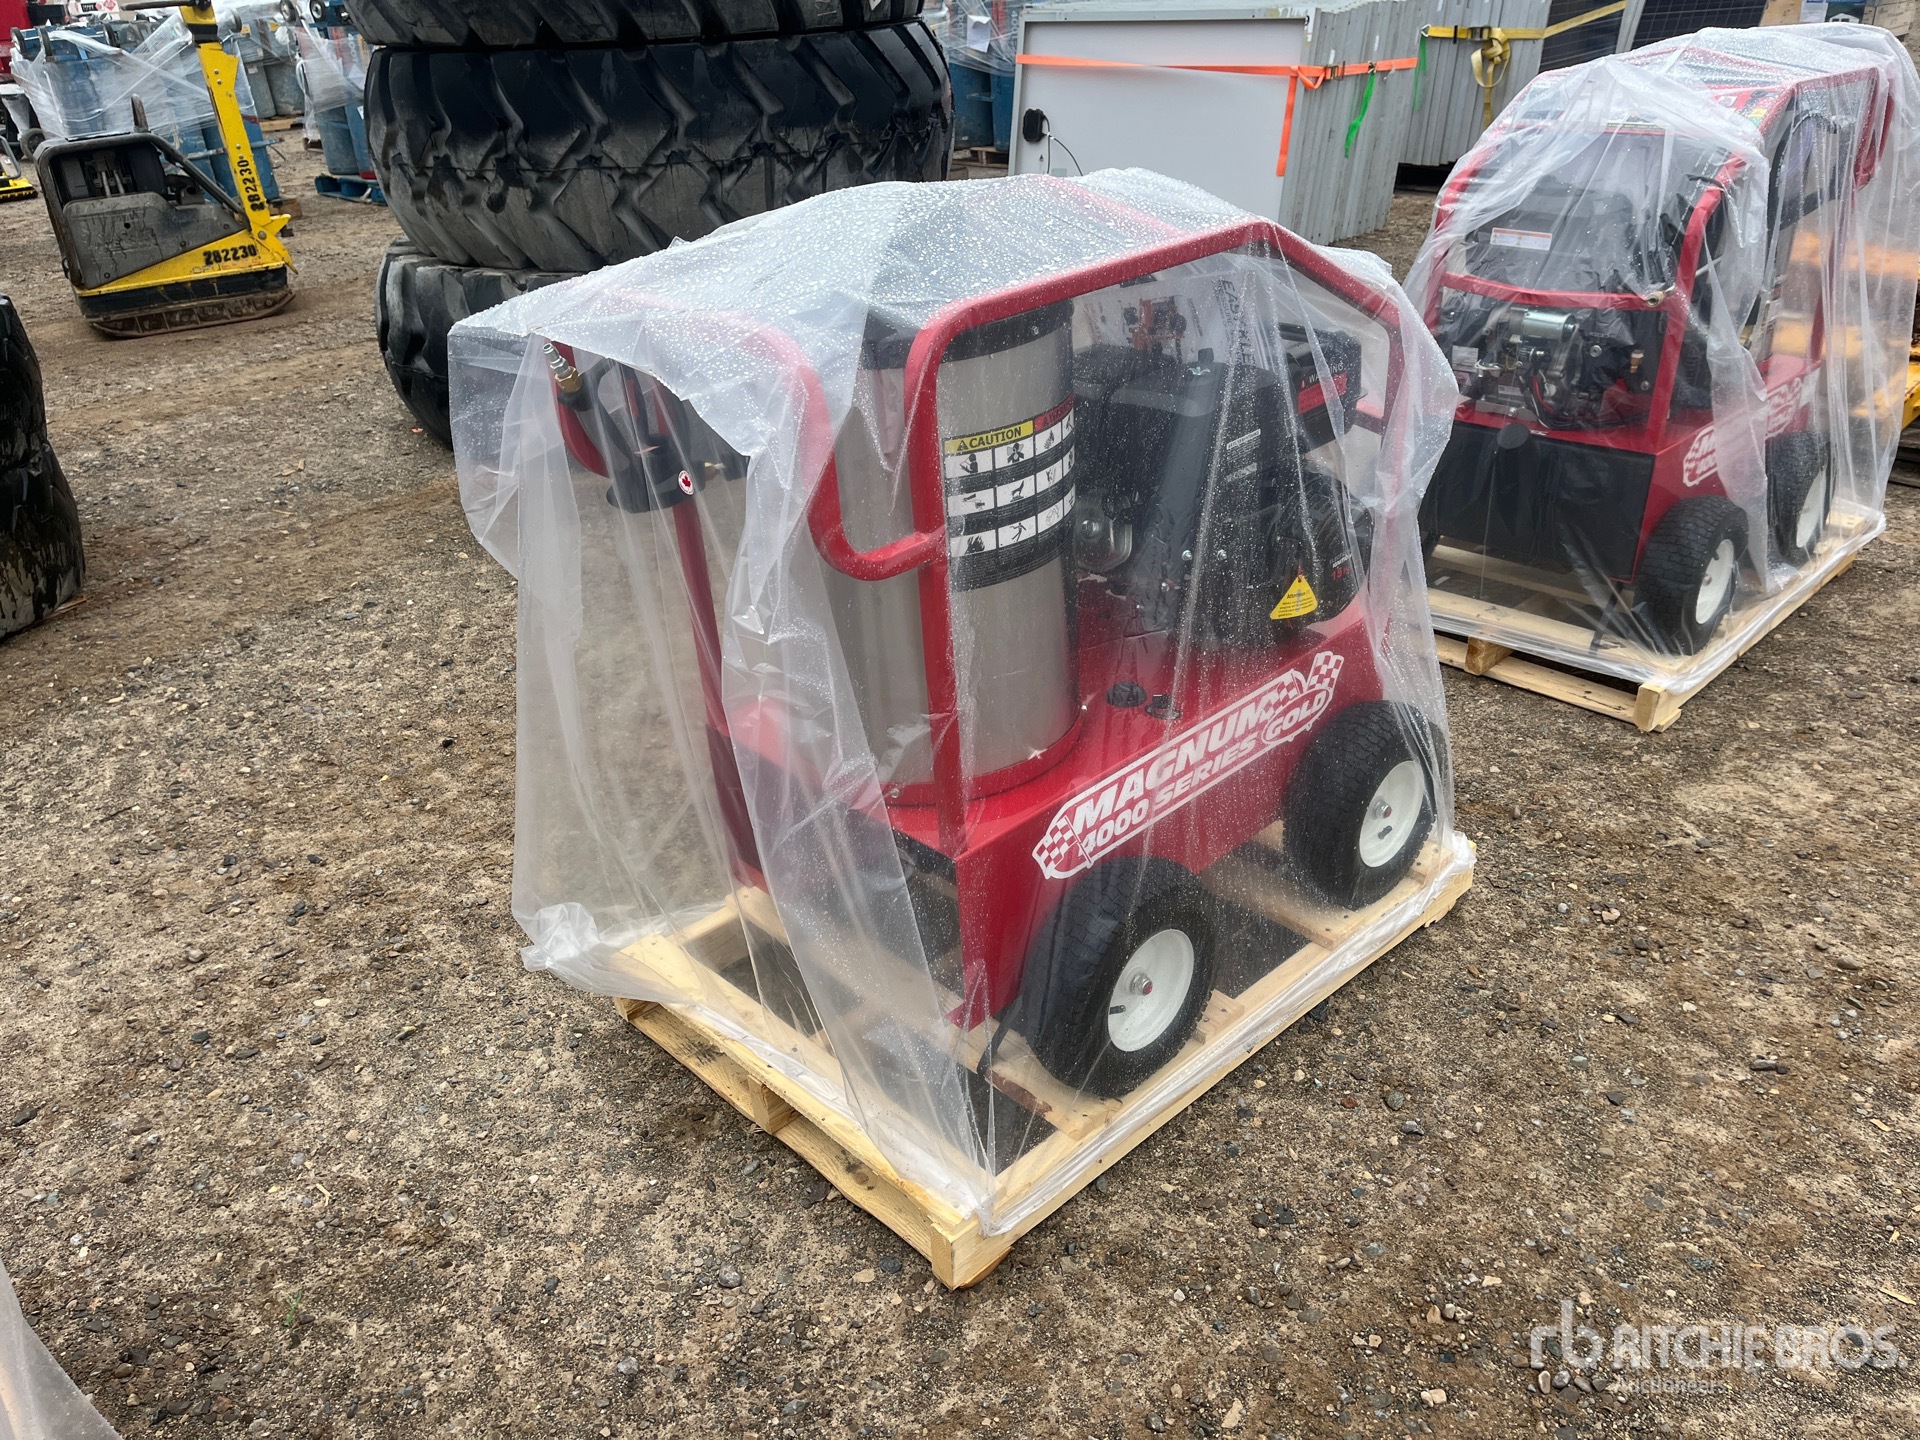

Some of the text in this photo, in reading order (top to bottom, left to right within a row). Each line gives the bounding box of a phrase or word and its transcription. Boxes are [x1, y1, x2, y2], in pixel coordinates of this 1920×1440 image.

[237, 159, 265, 212] 282230
[203, 244, 257, 266] 282230
[1309, 362, 1344, 383] WAING
[969, 426, 1021, 449] CAUTION
[1265, 691, 1327, 741] GOLD
[1072, 693, 1277, 835] MAGNUM
[1077, 733, 1257, 856] 4000 SERIES
